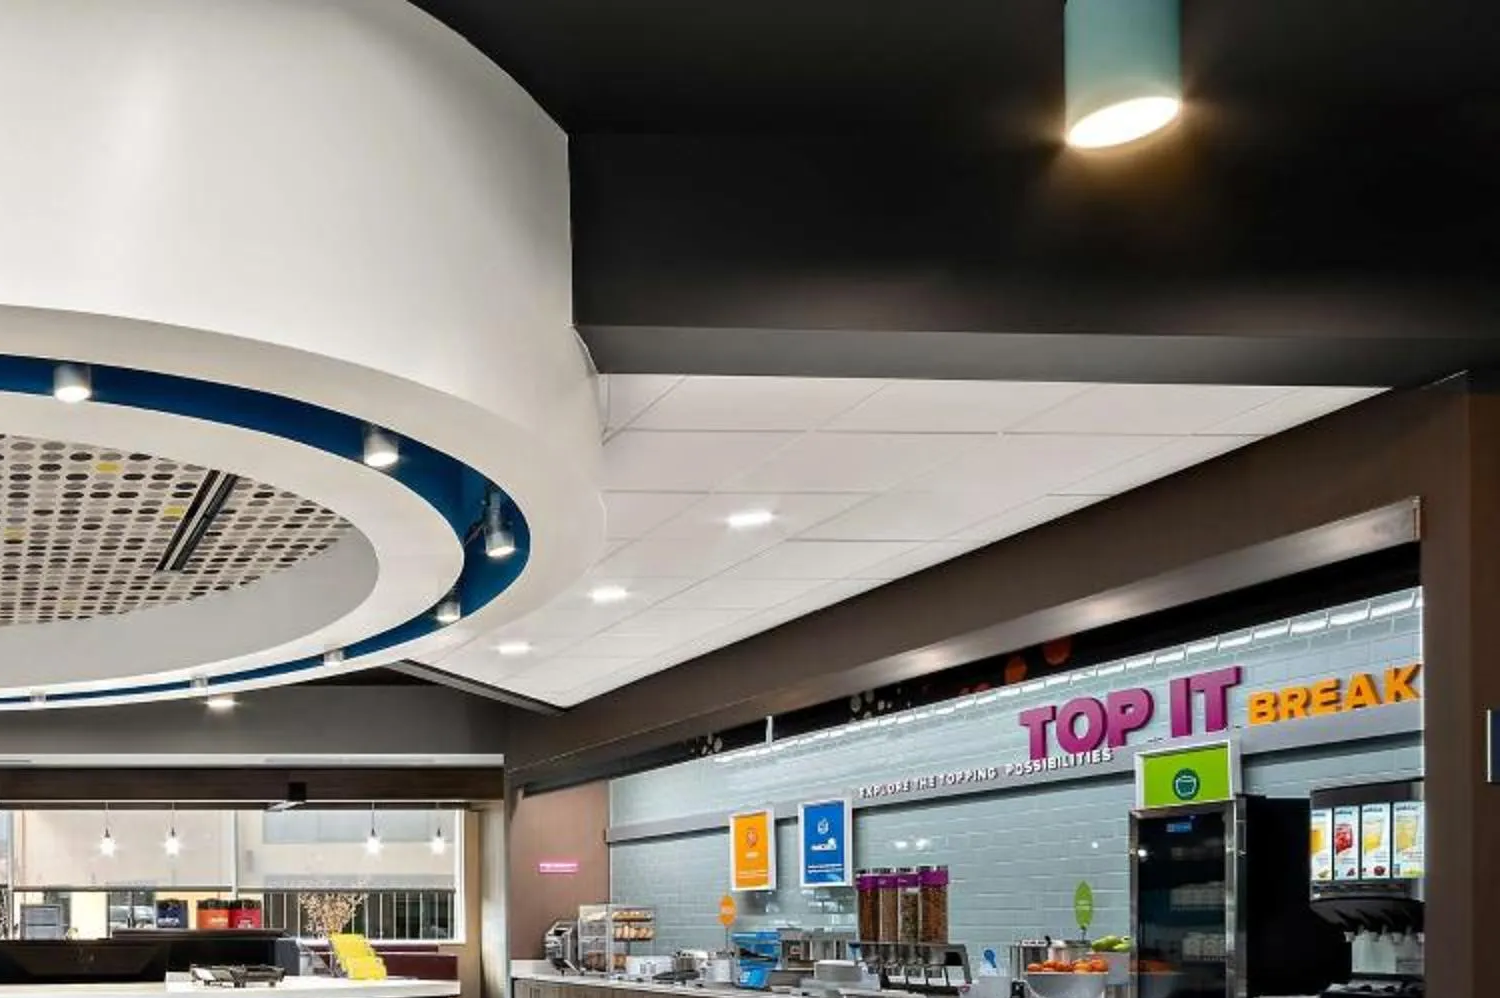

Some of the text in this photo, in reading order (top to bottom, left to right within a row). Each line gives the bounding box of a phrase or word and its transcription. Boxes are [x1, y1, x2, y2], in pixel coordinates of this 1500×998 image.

[1018, 665, 1243, 761] TOP IT
[1247, 664, 1422, 726] BREAK
[858, 748, 1115, 799] EXPLORE THE TOPPING POSSIBILITIES
